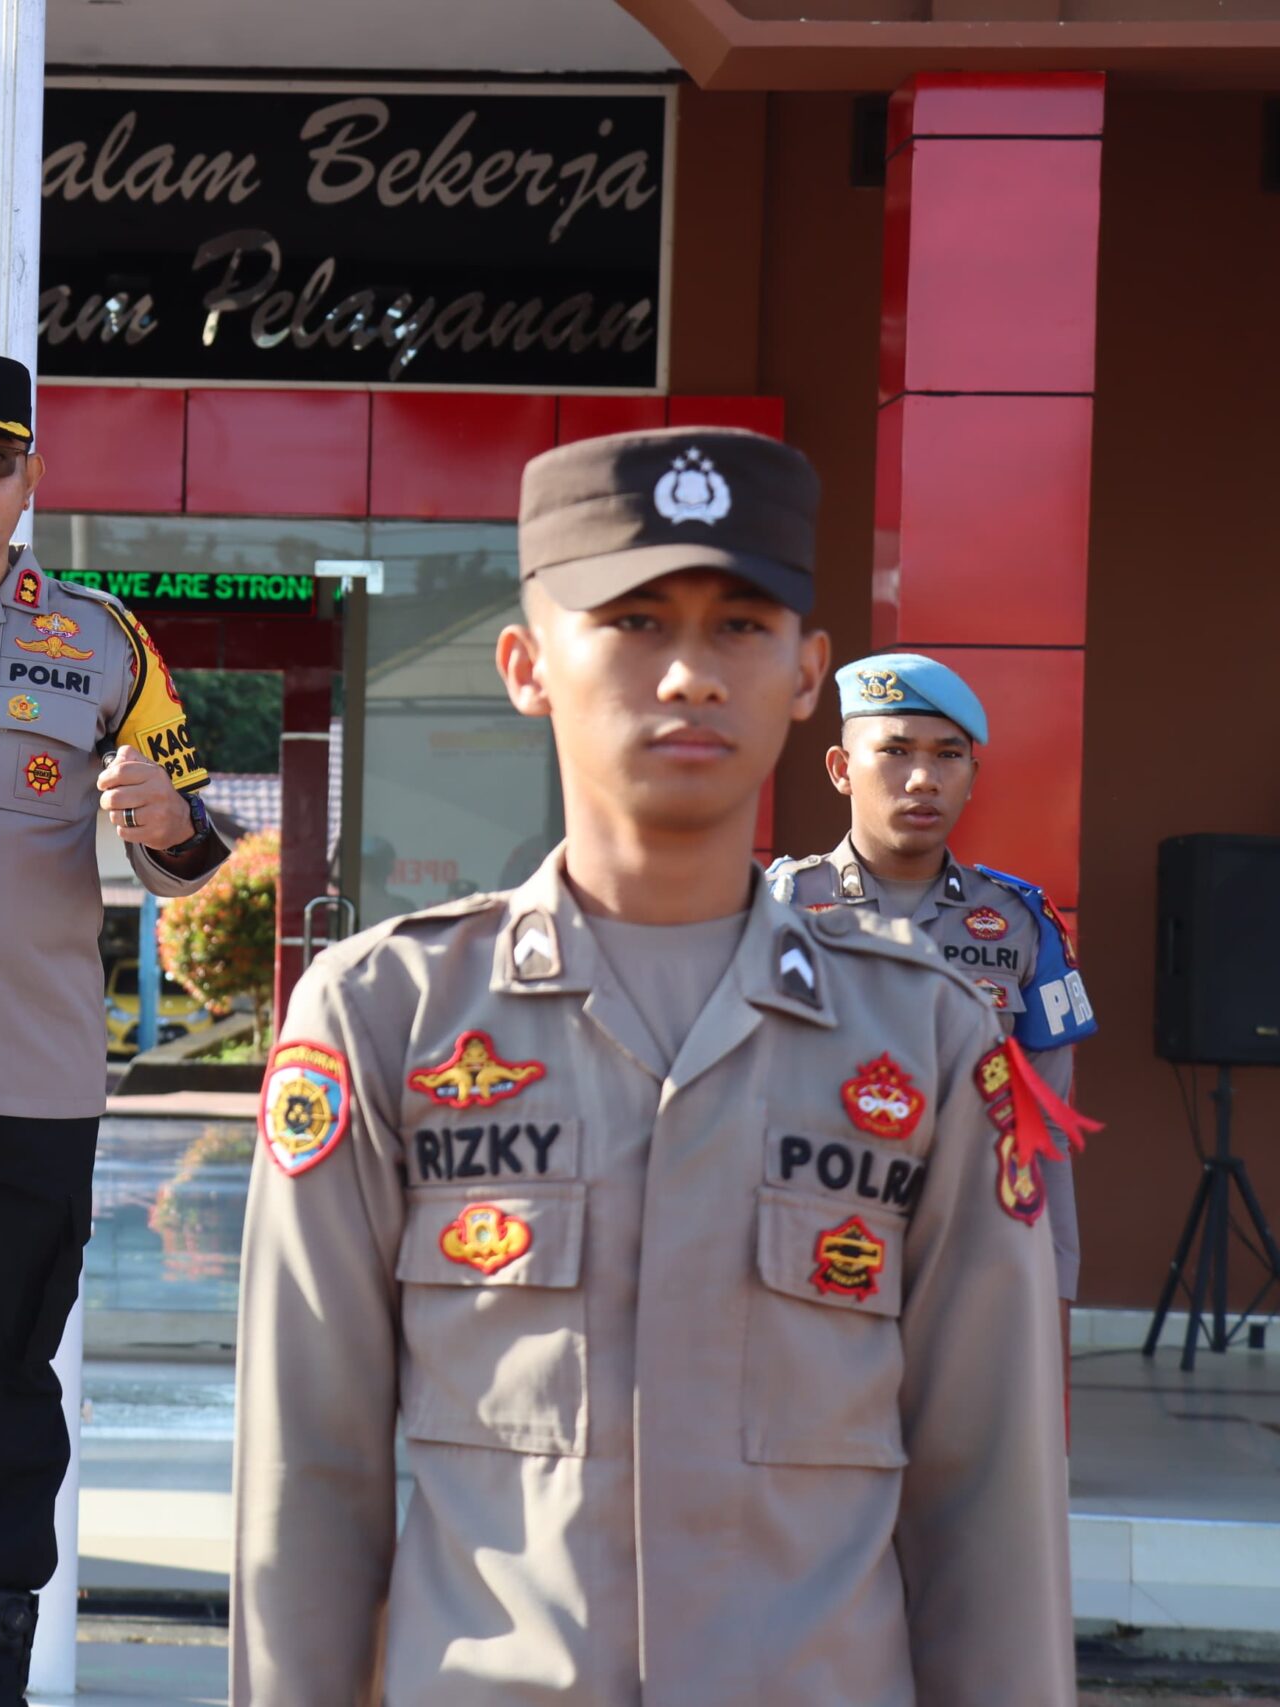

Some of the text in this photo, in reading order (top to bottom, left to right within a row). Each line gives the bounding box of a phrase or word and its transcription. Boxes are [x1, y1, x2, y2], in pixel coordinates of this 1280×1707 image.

[300, 98, 657, 242] Bekerja
[192, 229, 653, 380] Pelayanan
[107, 572, 149, 598] WE
[155, 573, 207, 599] ARE
[214, 574, 314, 601] STRON
[9, 662, 91, 695] POLRI
[944, 945, 1019, 970] POLRI
[415, 1122, 562, 1181] RIZKY
